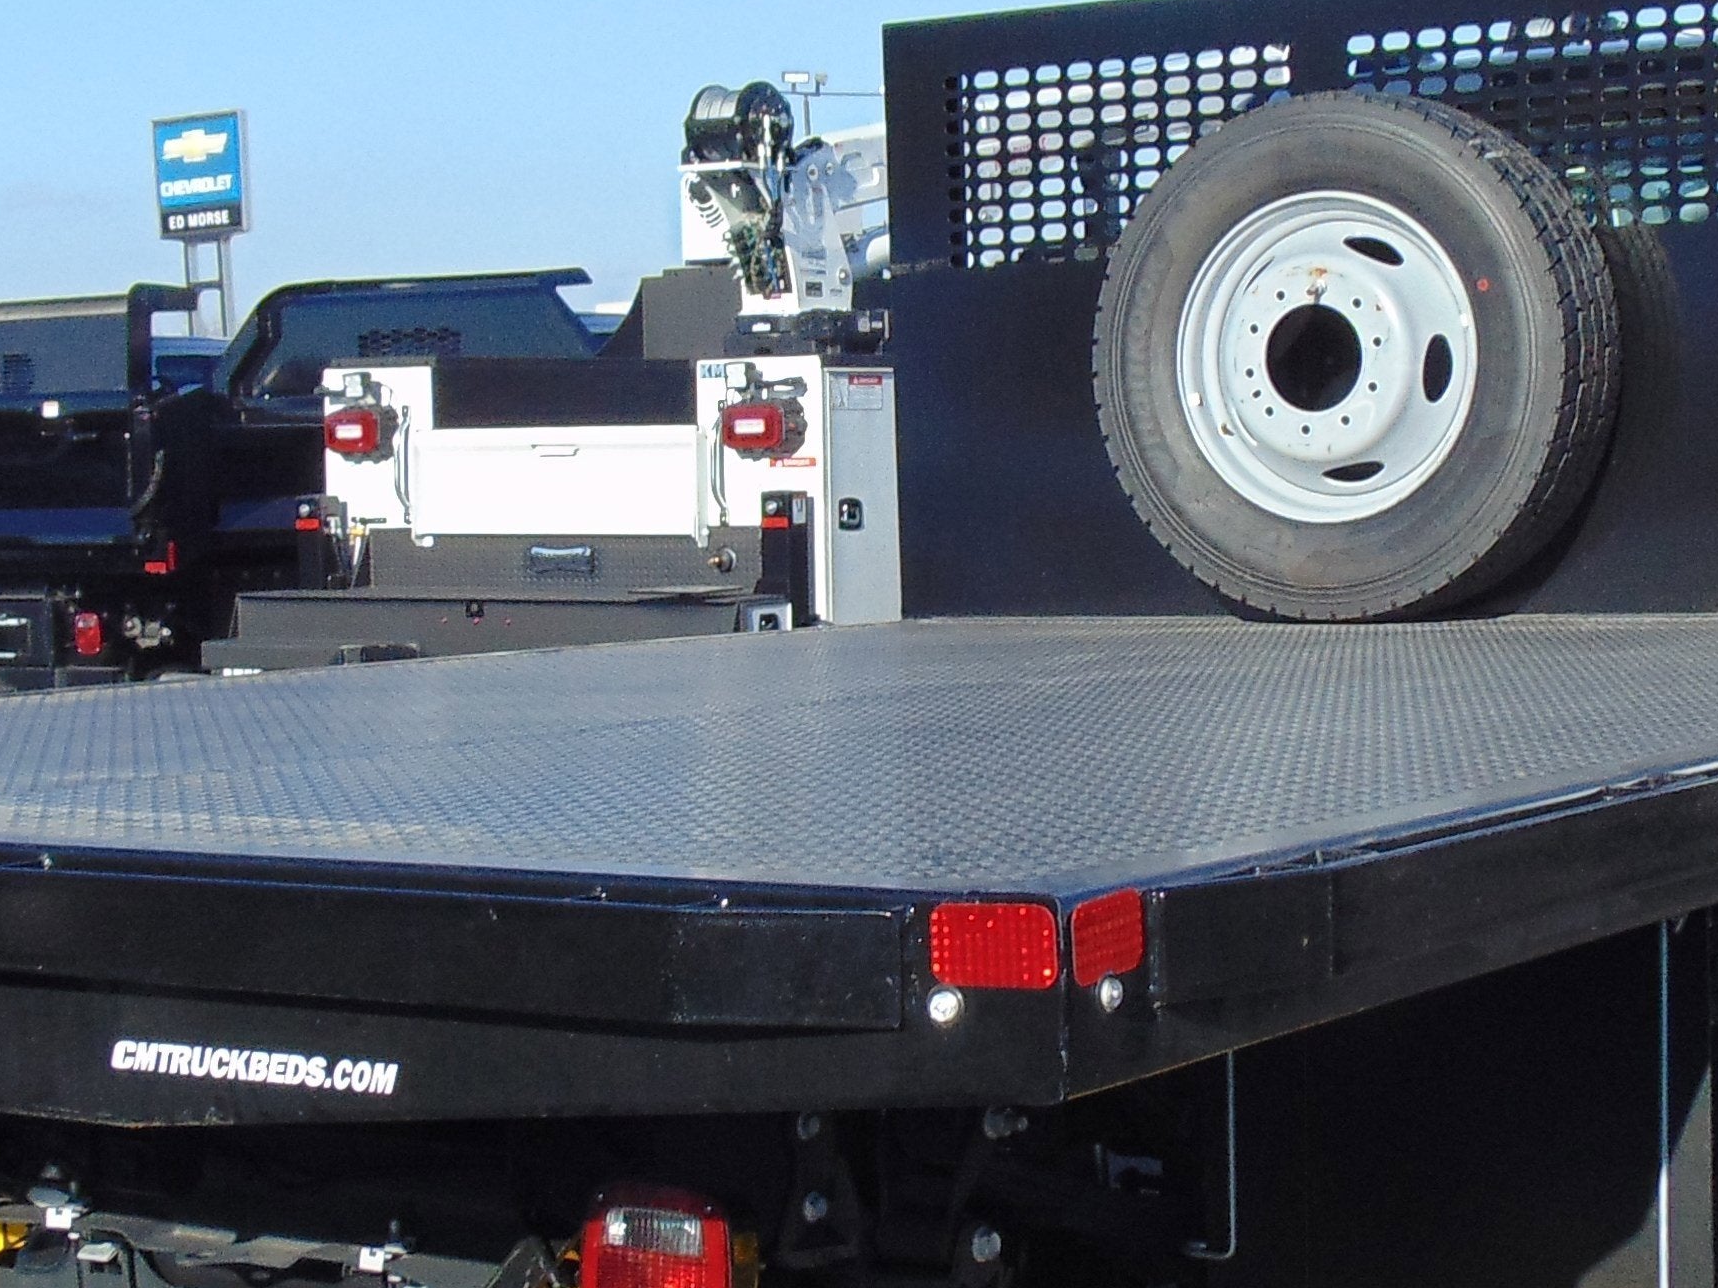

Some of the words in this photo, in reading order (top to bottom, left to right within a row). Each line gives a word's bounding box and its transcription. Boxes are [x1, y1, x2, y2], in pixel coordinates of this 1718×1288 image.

[160, 174, 232, 197] CHEVROLET
[168, 215, 185, 230] ED
[187, 209, 229, 228] MORSE
[110, 1039, 400, 1096] CMTRUCKBEDS.COM
